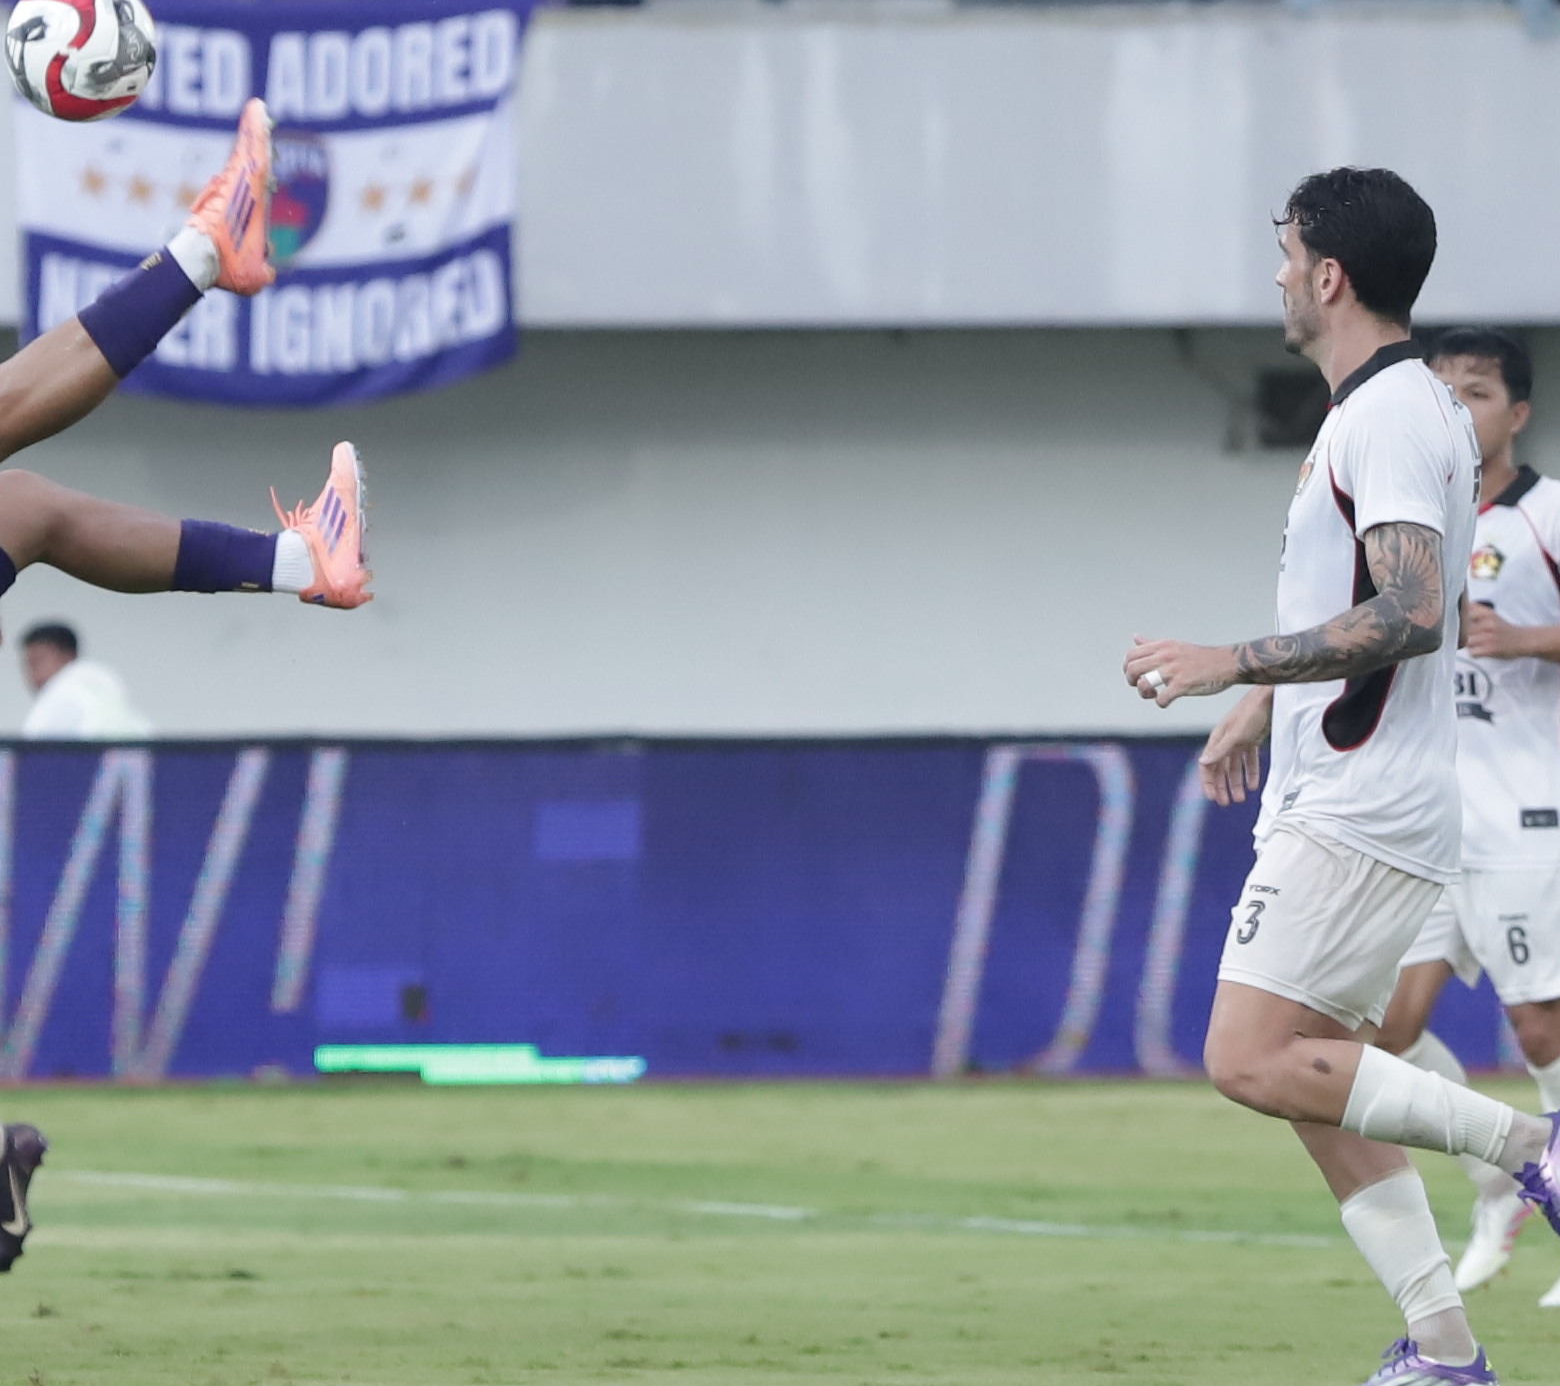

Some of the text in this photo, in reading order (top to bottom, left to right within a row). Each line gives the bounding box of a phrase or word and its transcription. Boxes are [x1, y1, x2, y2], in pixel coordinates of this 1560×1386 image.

[138, 9, 518, 119] TED ADORED
[39, 248, 506, 376] NER IGNORED
[1236, 899, 1267, 945] 3
[1505, 926, 1530, 966] 6
